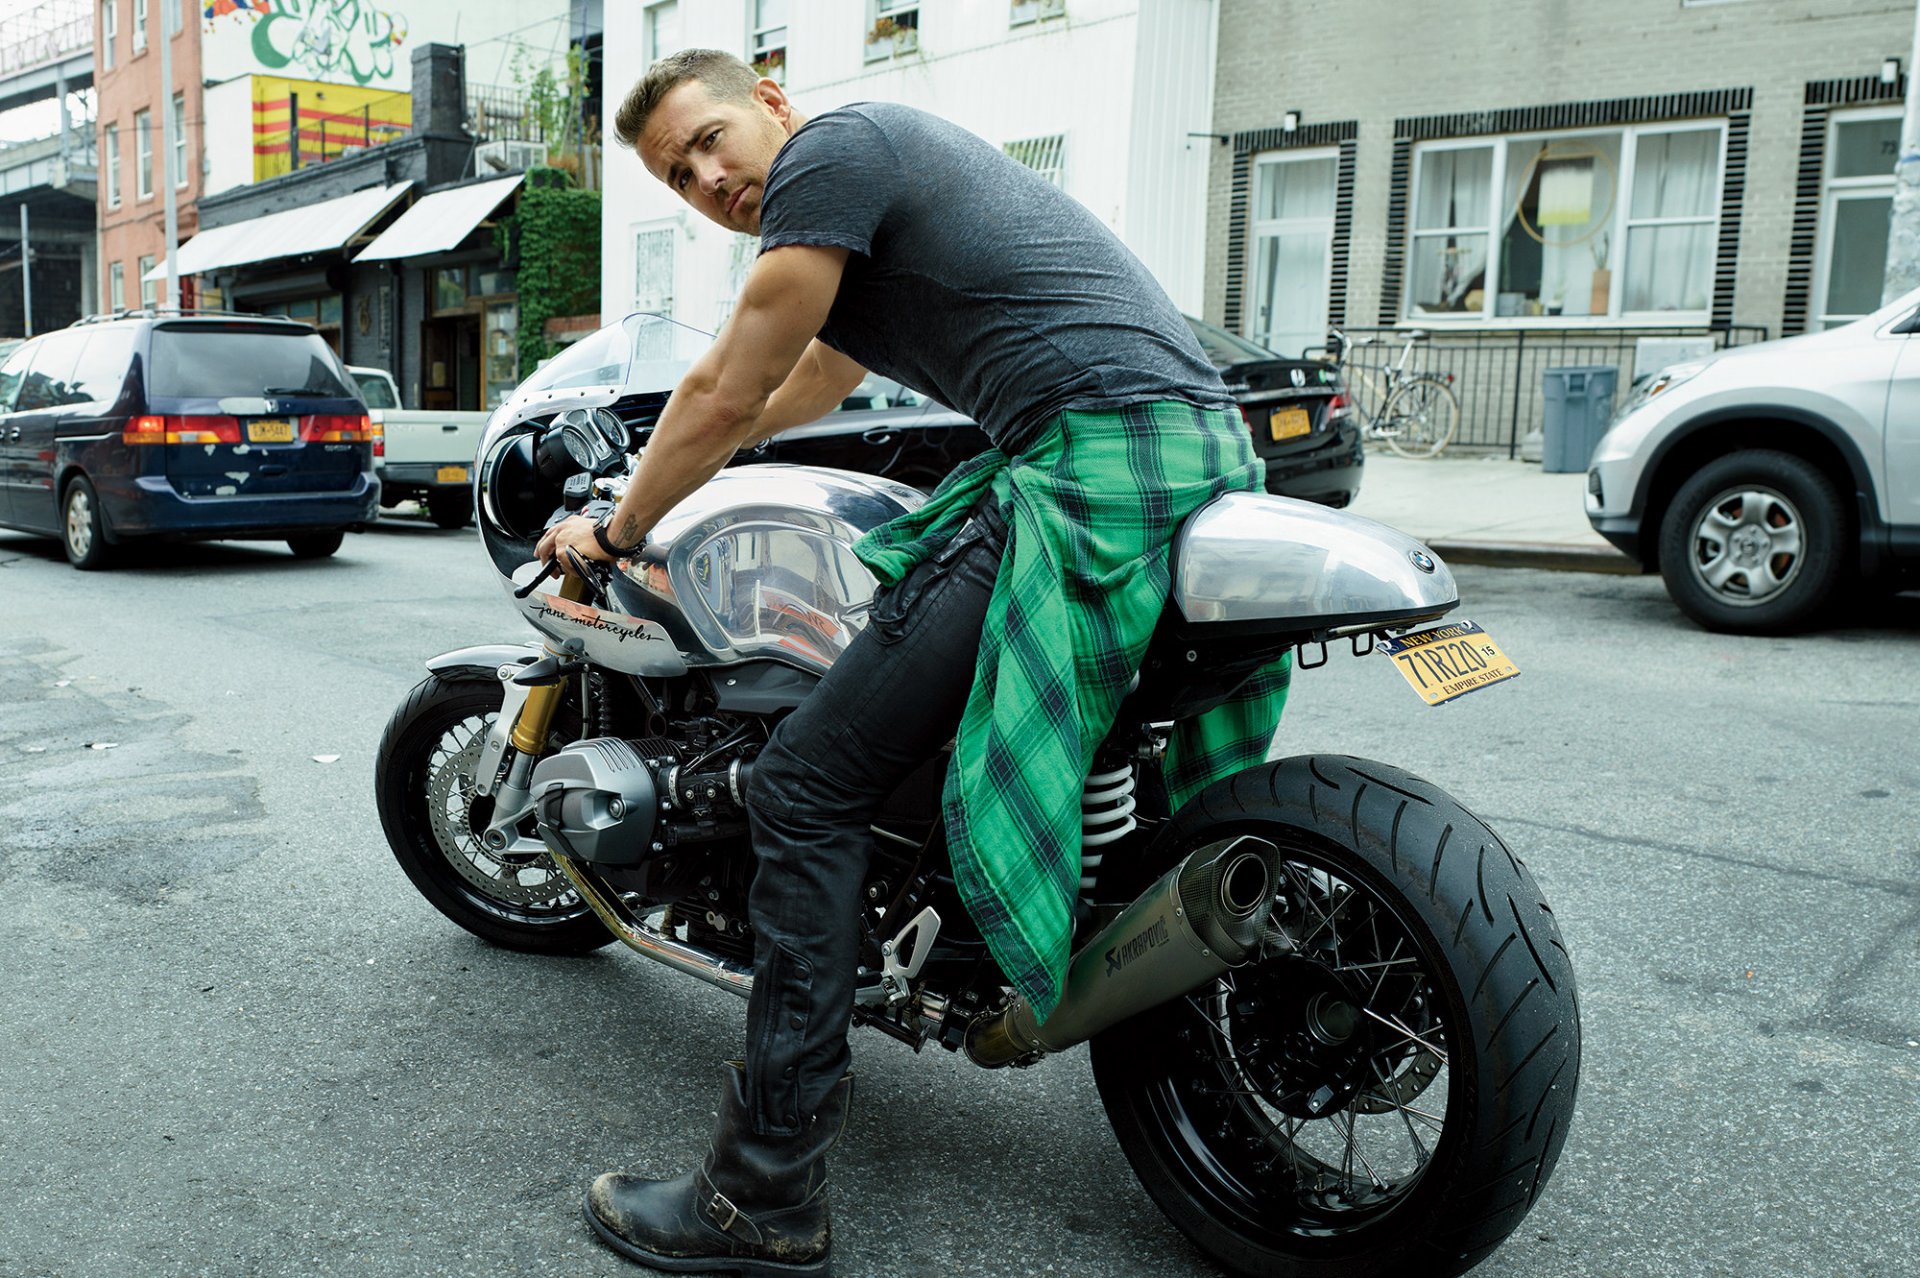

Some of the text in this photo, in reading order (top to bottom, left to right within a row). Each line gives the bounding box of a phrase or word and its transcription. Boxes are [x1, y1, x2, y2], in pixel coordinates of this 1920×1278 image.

[529, 603, 665, 642] jane motorcycles
[1399, 626, 1467, 648] NEW YORK
[1397, 640, 1488, 689] 71RZ20
[1481, 646, 1496, 656] 15
[1443, 668, 1504, 695] EMPIRE STATE
